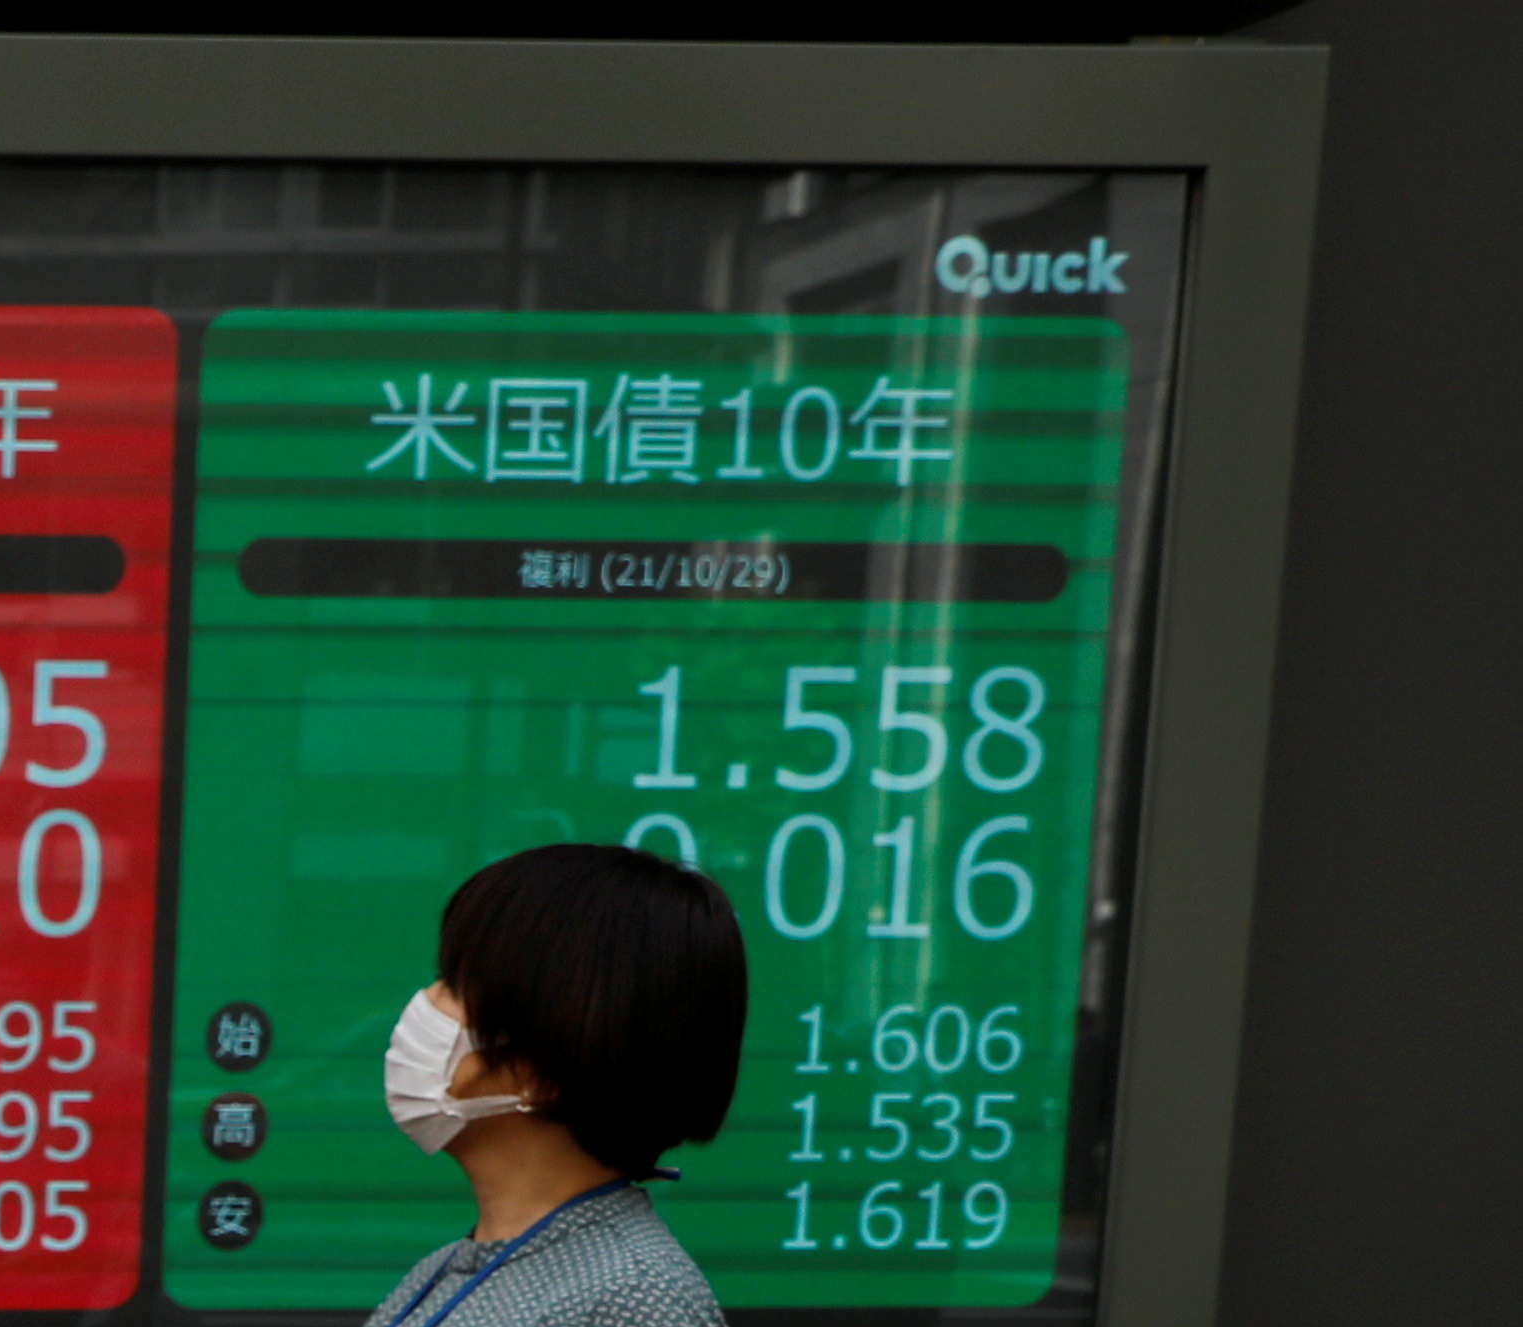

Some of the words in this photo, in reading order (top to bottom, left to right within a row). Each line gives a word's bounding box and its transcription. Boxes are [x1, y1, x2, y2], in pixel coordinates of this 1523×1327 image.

[366, 372, 956, 486] 米国債10年
[601, 551, 791, 594] (21/10/29)
[632, 665, 1046, 794] 1.558
[216, 1012, 261, 1058] 始
[798, 1005, 1020, 1071] 1.606
[214, 1102, 256, 1147] 高
[793, 1093, 1014, 1158] 1.535
[209, 1193, 252, 1236] 安
[785, 1183, 1006, 1247] 1.619
